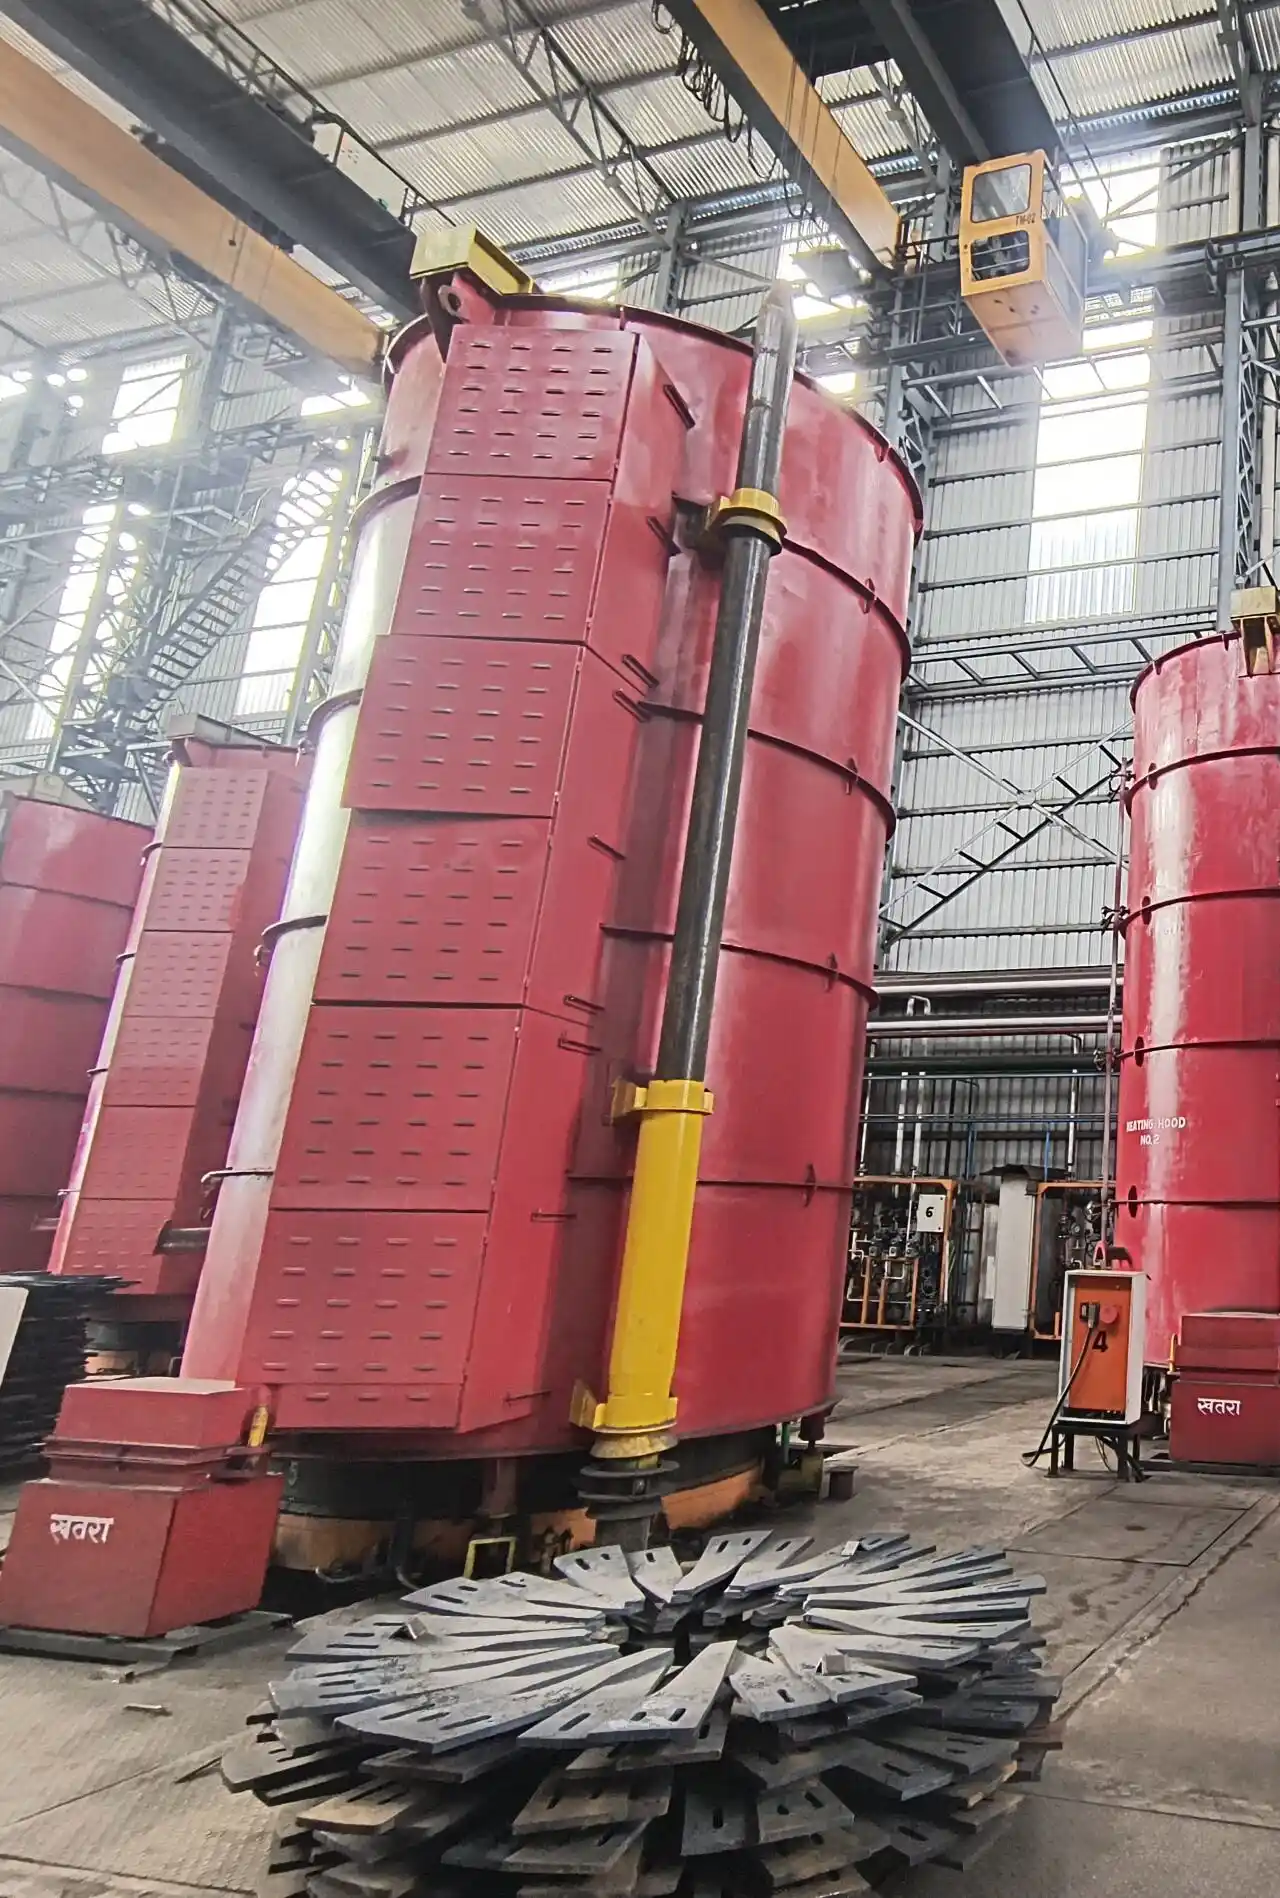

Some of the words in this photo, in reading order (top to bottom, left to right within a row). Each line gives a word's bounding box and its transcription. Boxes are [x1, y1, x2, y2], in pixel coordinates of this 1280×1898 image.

[1158, 1116, 1186, 1129] HOOD
[925, 1206, 935, 1218] 6
[1092, 1330, 1109, 1353] 4
[1197, 1397, 1242, 1416] खतरा
